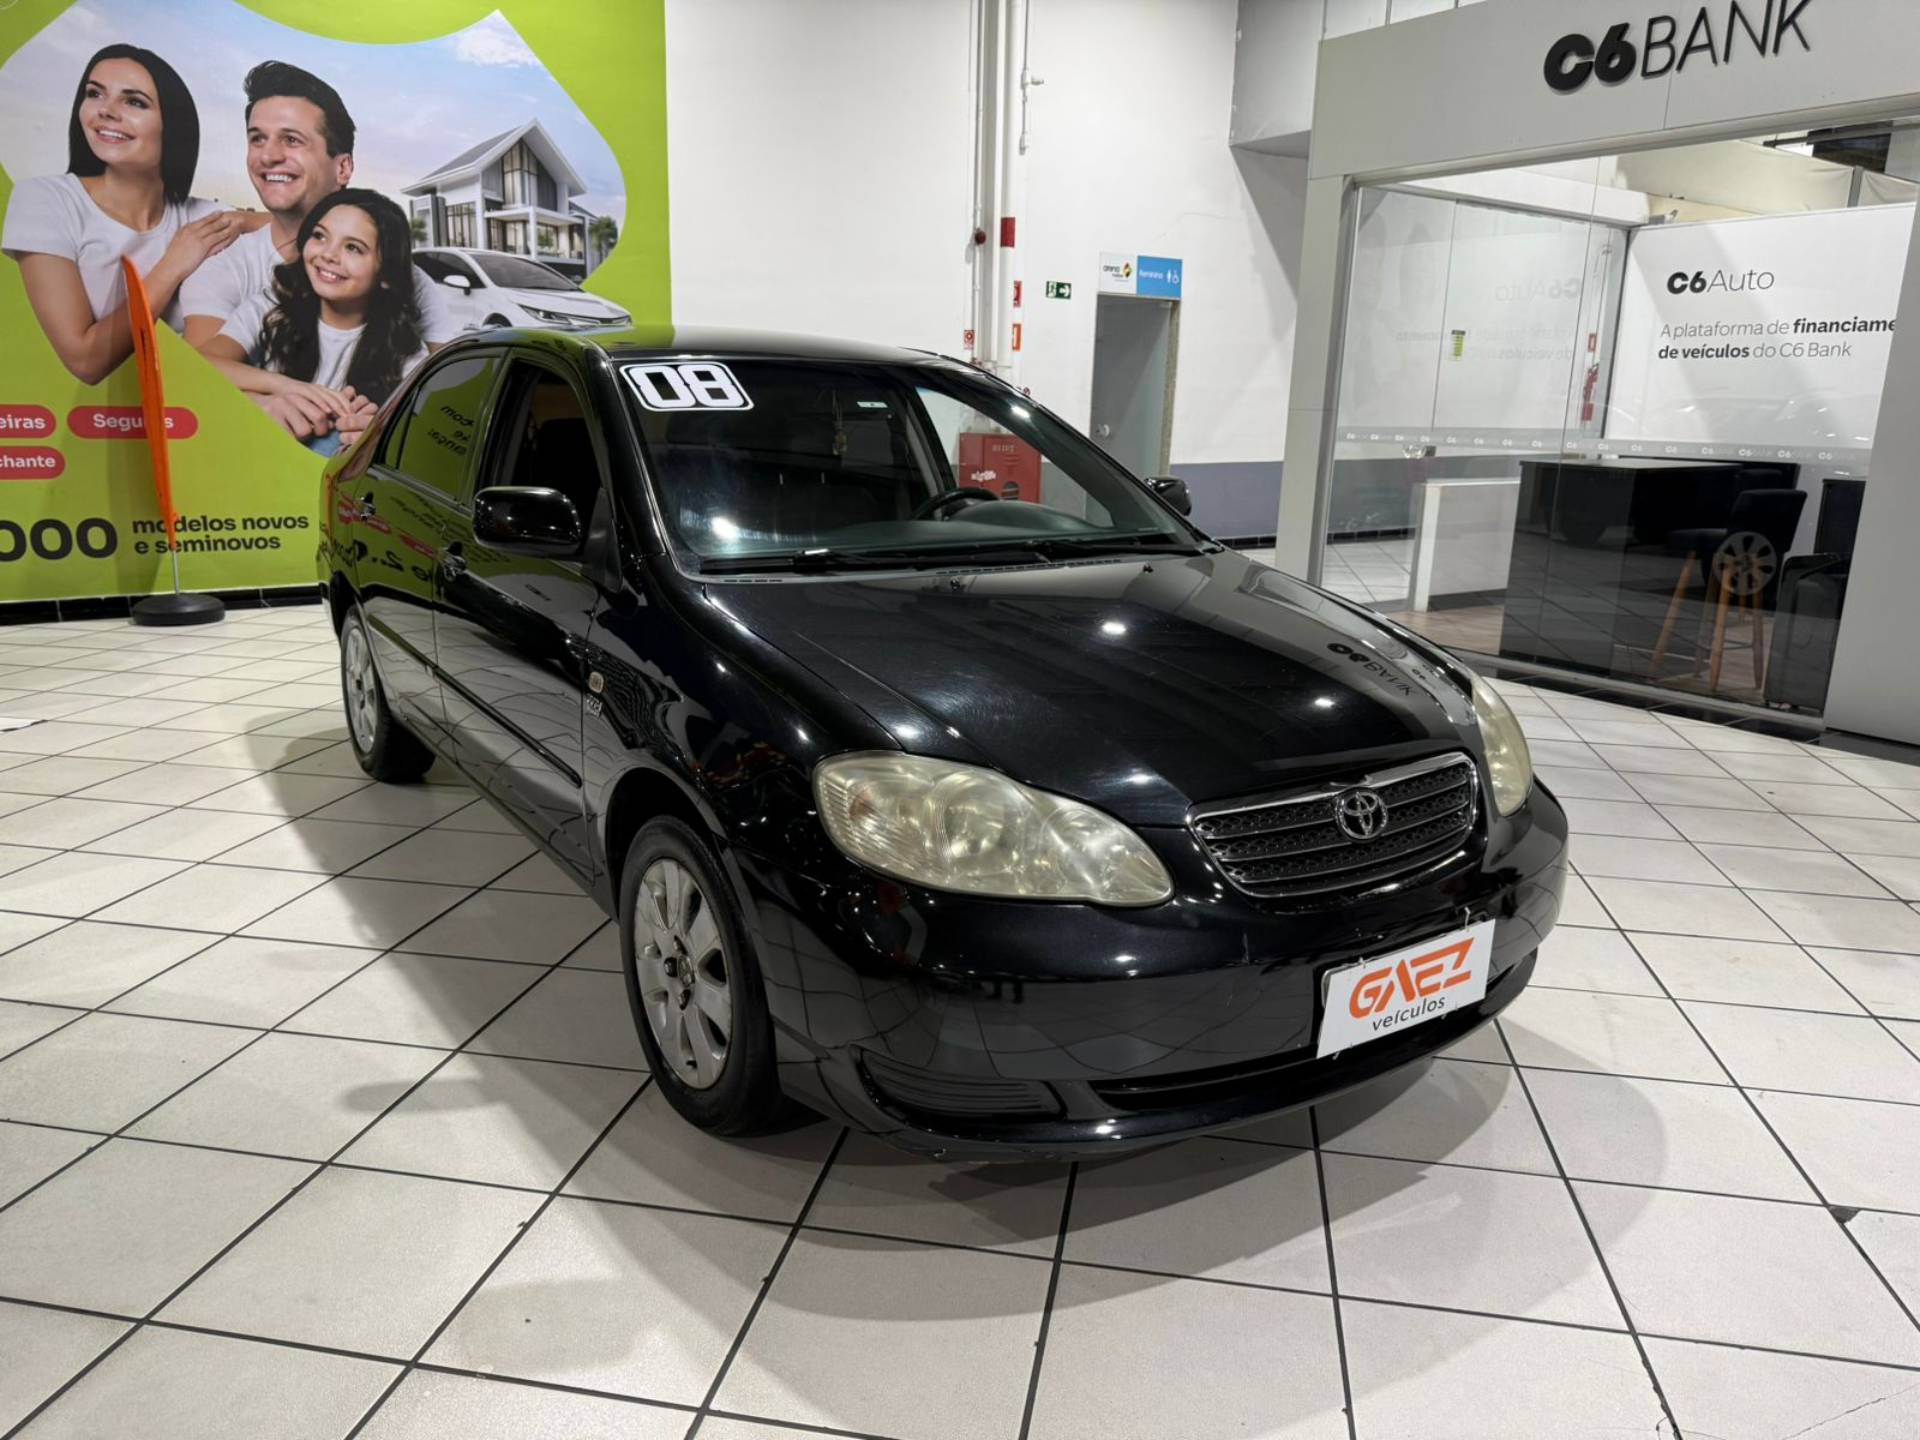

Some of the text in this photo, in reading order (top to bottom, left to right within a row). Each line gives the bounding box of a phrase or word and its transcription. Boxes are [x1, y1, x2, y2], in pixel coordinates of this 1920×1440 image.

[1667, 269, 1775, 295] C6Auto
[1660, 324, 1672, 338] A
[1673, 321, 1764, 340] plataforma
[1766, 320, 1790, 335] de
[1658, 341, 1852, 359] de veículos do C6 Bank
[629, 364, 744, 408] 08
[93, 413, 174, 432] Segus
[242, 514, 309, 530] novos
[134, 540, 149, 554] e
